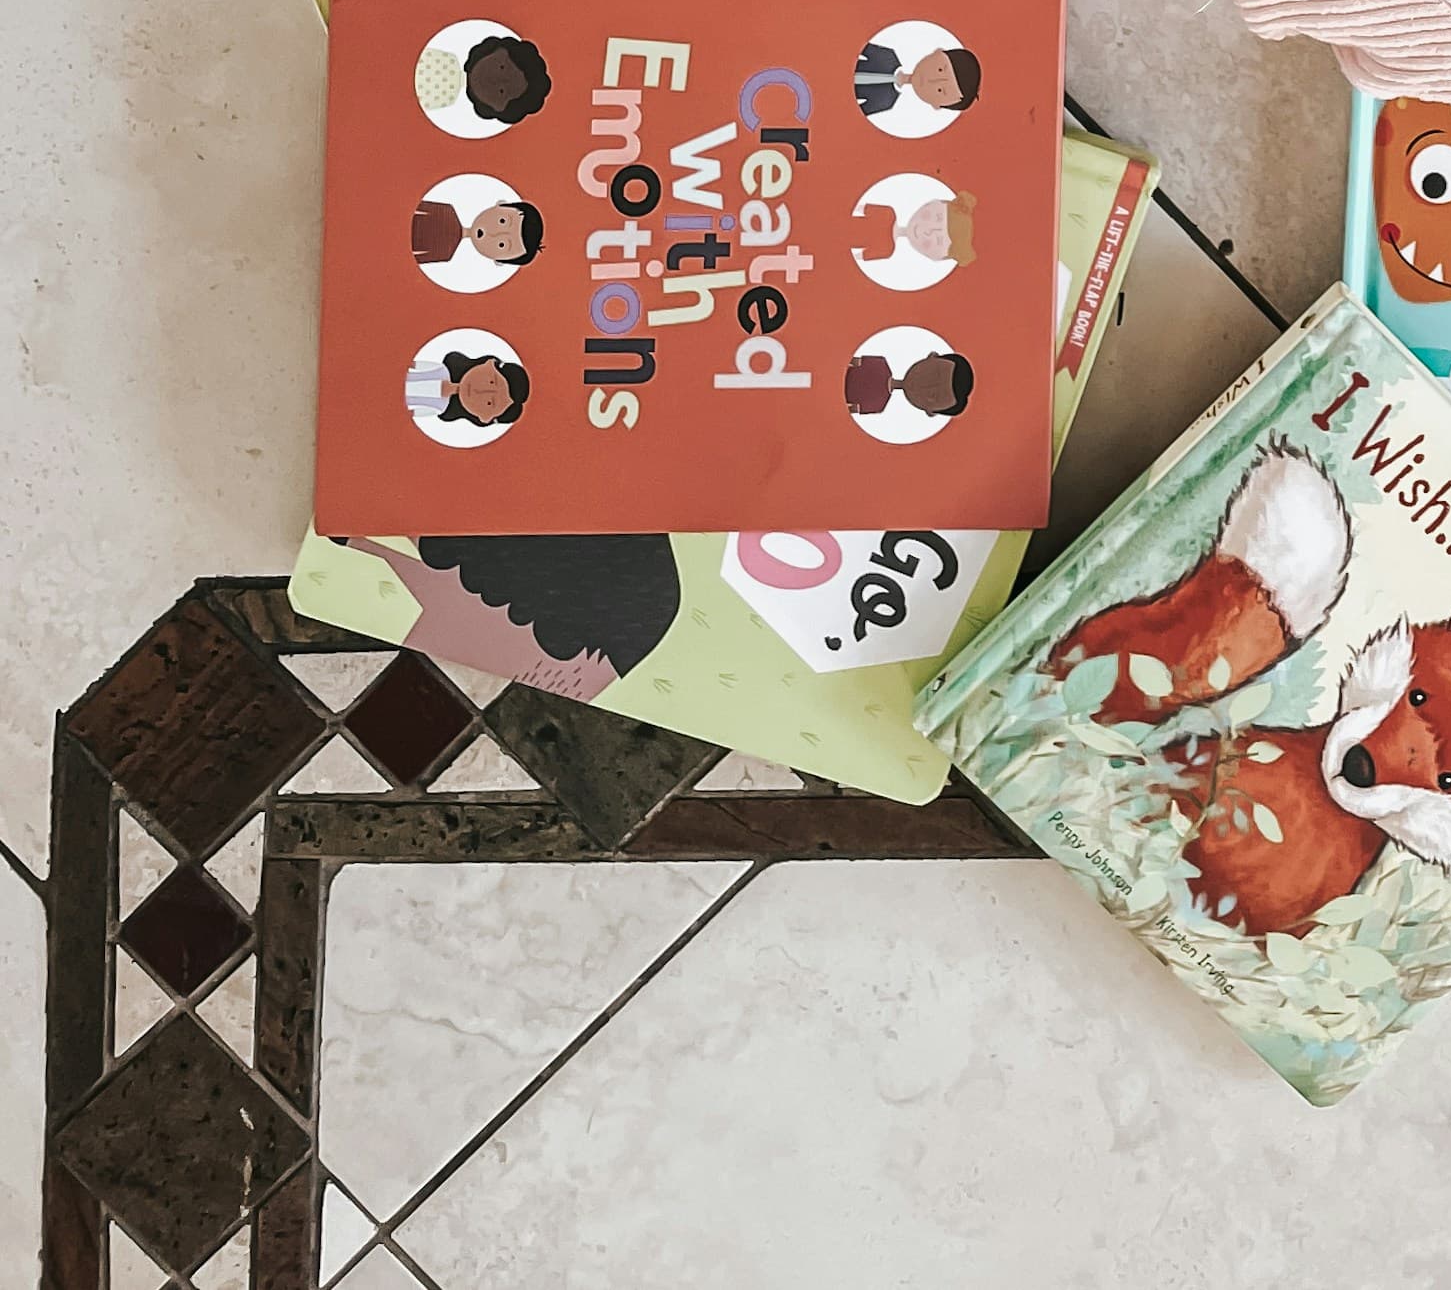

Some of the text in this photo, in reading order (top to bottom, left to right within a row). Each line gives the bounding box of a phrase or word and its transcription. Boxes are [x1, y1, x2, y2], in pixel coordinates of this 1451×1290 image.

[577, 36, 691, 431] Emotions
[648, 122, 746, 328] with
[714, 66, 814, 391] Created
[1068, 205, 1129, 347] A LIFT-THE-FLAP BOOK!
[1312, 371, 1369, 434] I
[1046, 809, 1135, 897] Penny Johnson
[1153, 914, 1238, 997] Kirsten Irving
